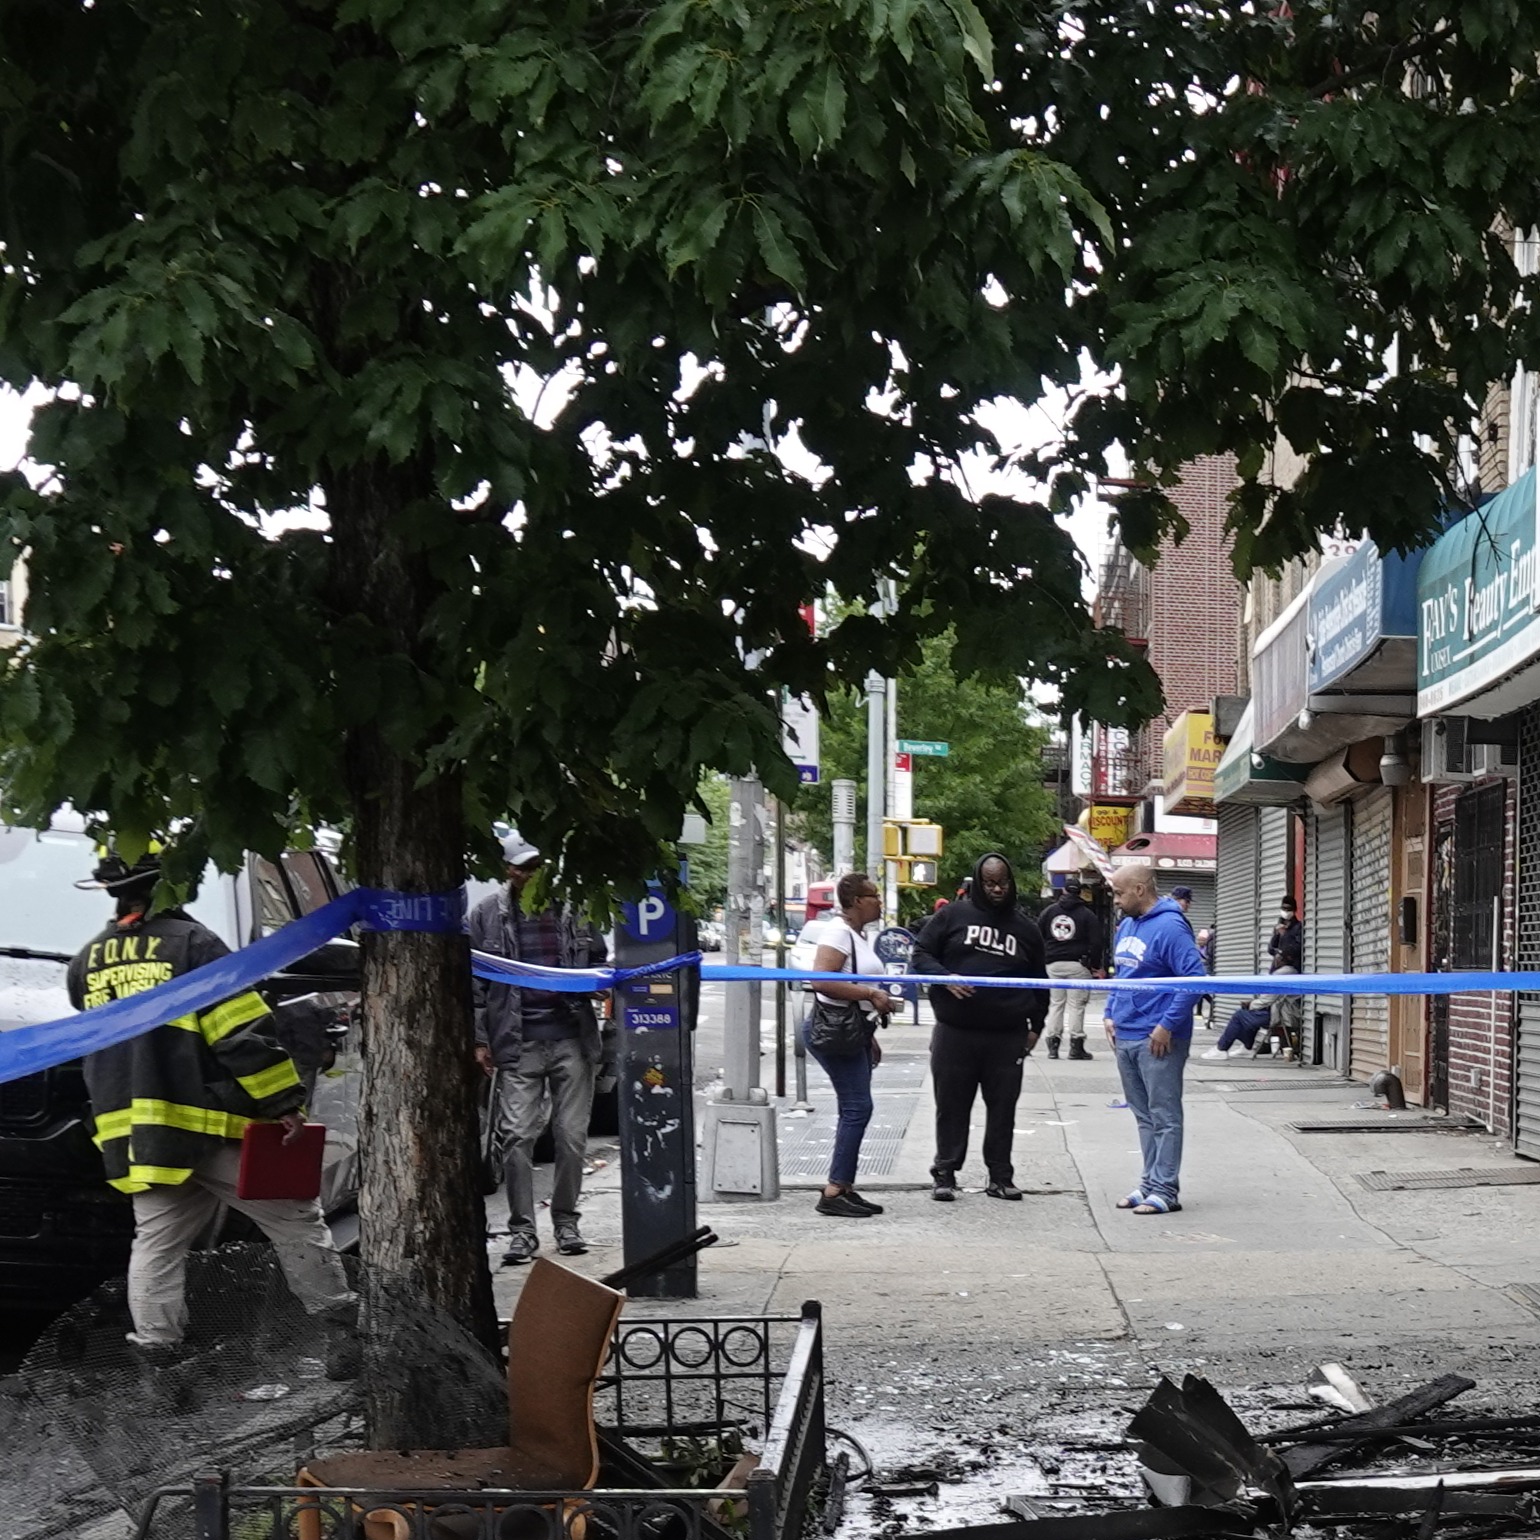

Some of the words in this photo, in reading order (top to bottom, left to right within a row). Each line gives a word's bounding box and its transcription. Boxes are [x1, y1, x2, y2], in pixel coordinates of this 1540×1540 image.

[1422, 583, 1457, 677] FAY'S
[1463, 570, 1508, 641] Beauty
[1508, 539, 1536, 615] Emp
[1190, 748, 1223, 763] MAR
[964, 924, 1017, 957] POLO
[86, 961, 173, 992] SUPERVISING
[631, 1013, 672, 1026] 313388
